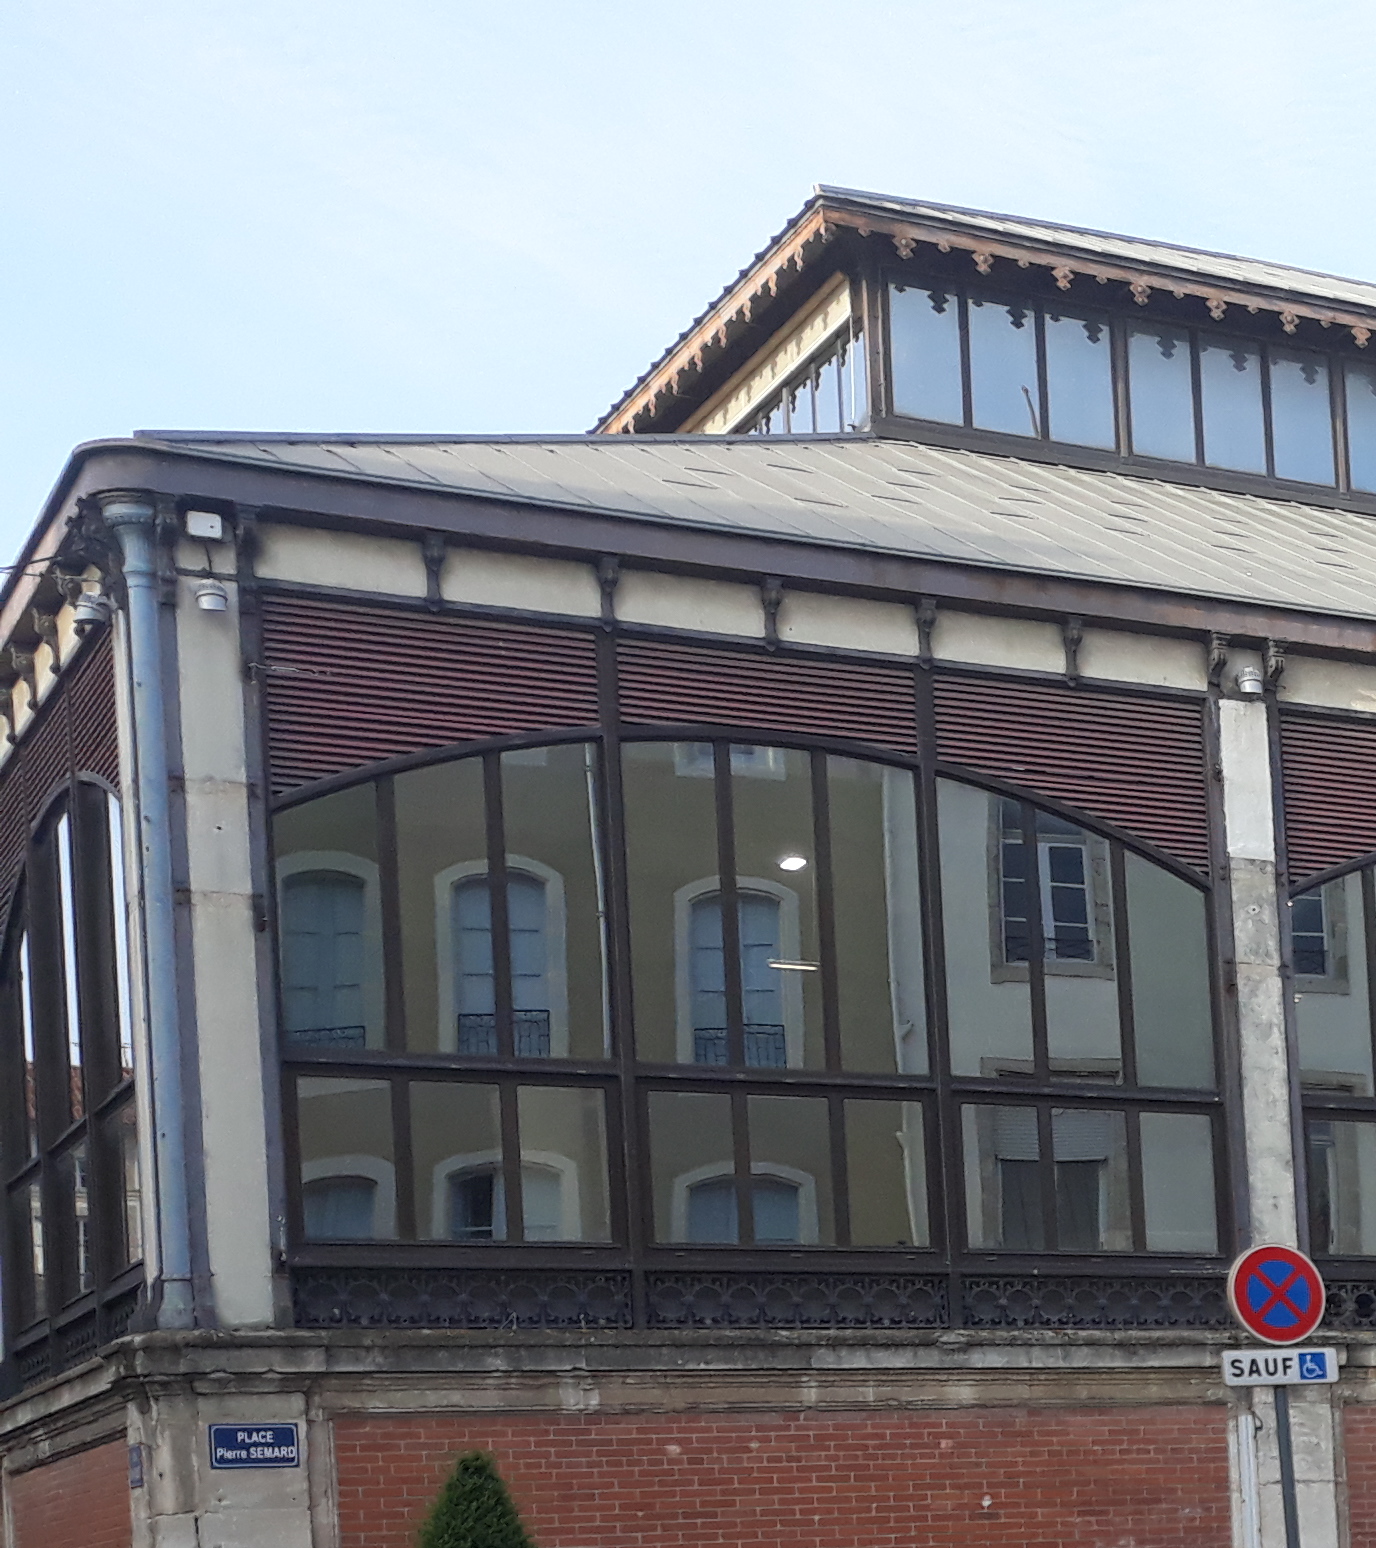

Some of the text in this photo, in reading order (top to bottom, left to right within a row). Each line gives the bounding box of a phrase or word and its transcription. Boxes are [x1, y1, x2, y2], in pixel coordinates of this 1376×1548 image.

[1230, 1357, 1293, 1377] SAUF
[236, 1431, 275, 1443] PLACE
[216, 1446, 296, 1459] Pierre SEMARD
